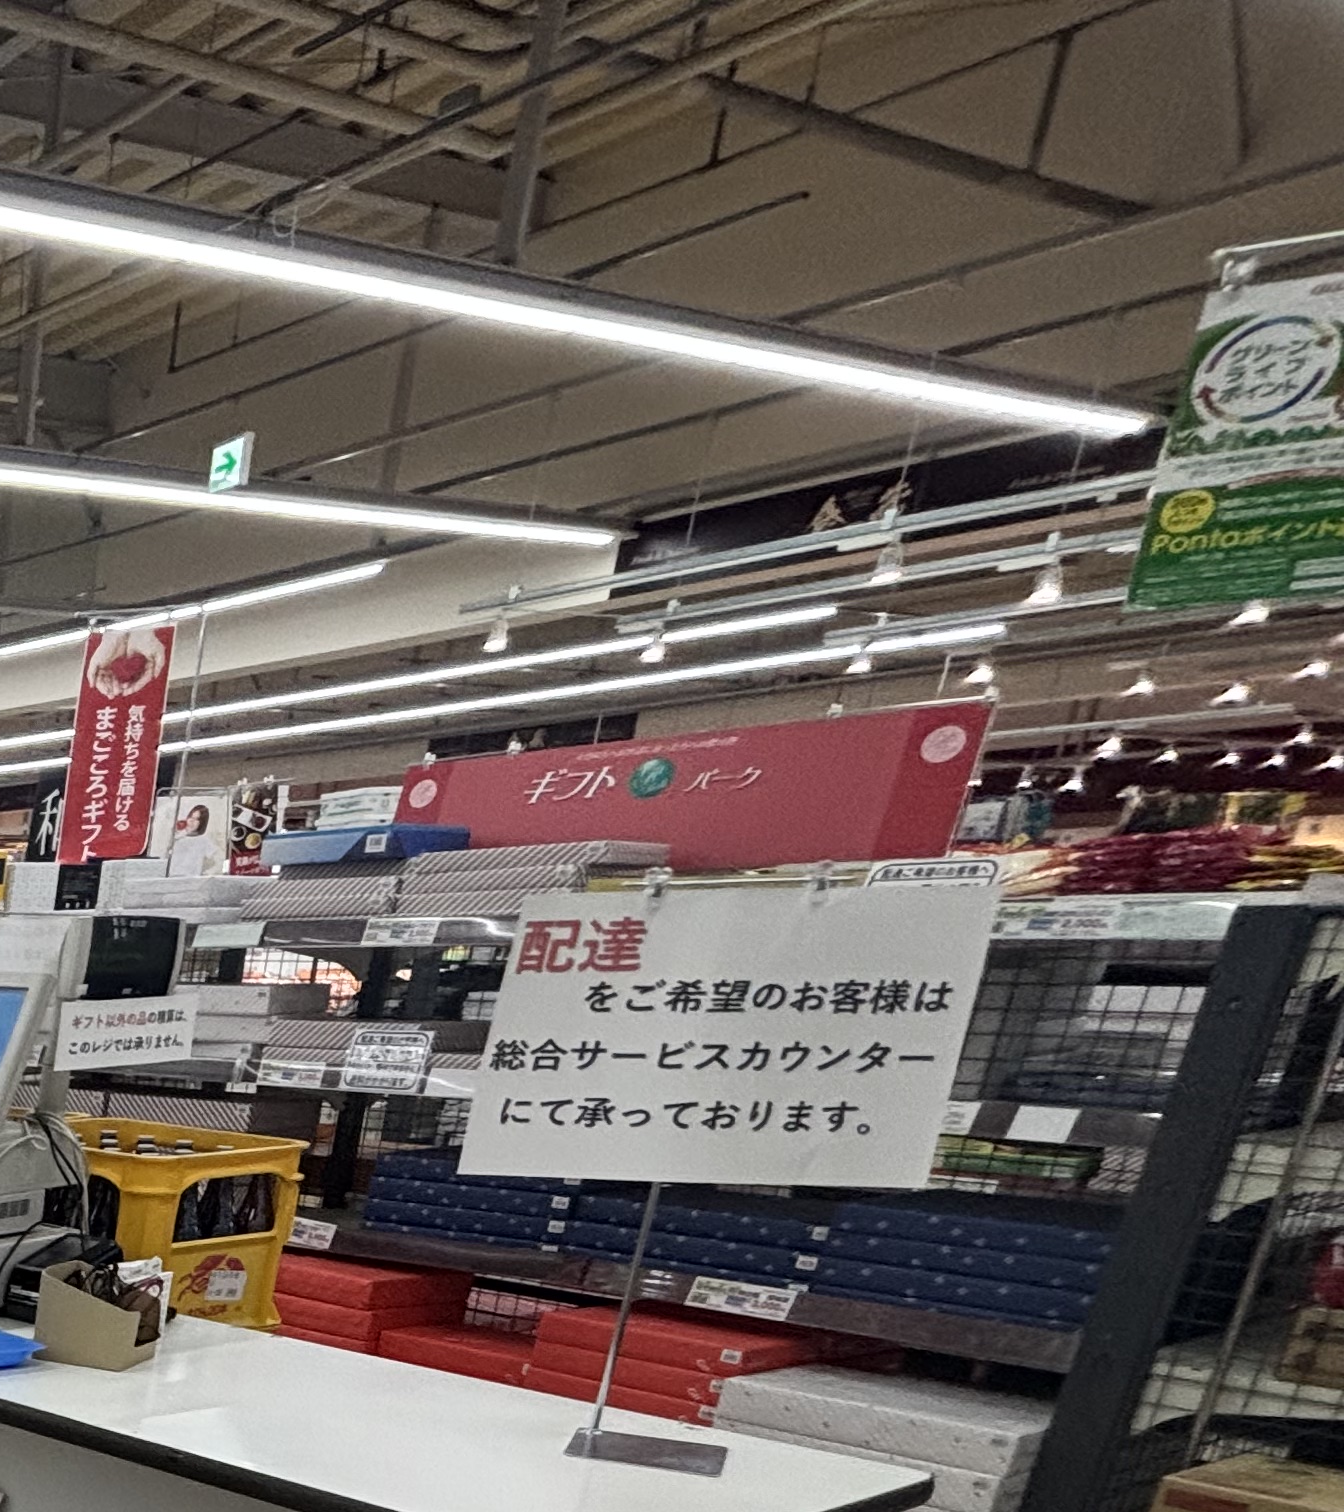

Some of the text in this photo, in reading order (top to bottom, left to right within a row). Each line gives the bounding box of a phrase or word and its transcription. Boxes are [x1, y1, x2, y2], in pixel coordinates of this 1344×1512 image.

[1231, 339, 1313, 364] グリーン
[80, 705, 119, 863] まごころギフト
[113, 704, 147, 832] 気持ちを届ける
[523, 765, 616, 805] ギフト
[682, 766, 763, 793] パーク
[514, 917, 649, 975] 配達
[586, 978, 954, 1015] をご希望のお客様は
[67, 1033, 185, 1055] このレジでは承りません。
[488, 1037, 936, 1074] 総合サービスカウンター
[498, 1097, 874, 1137] にて承っております。
